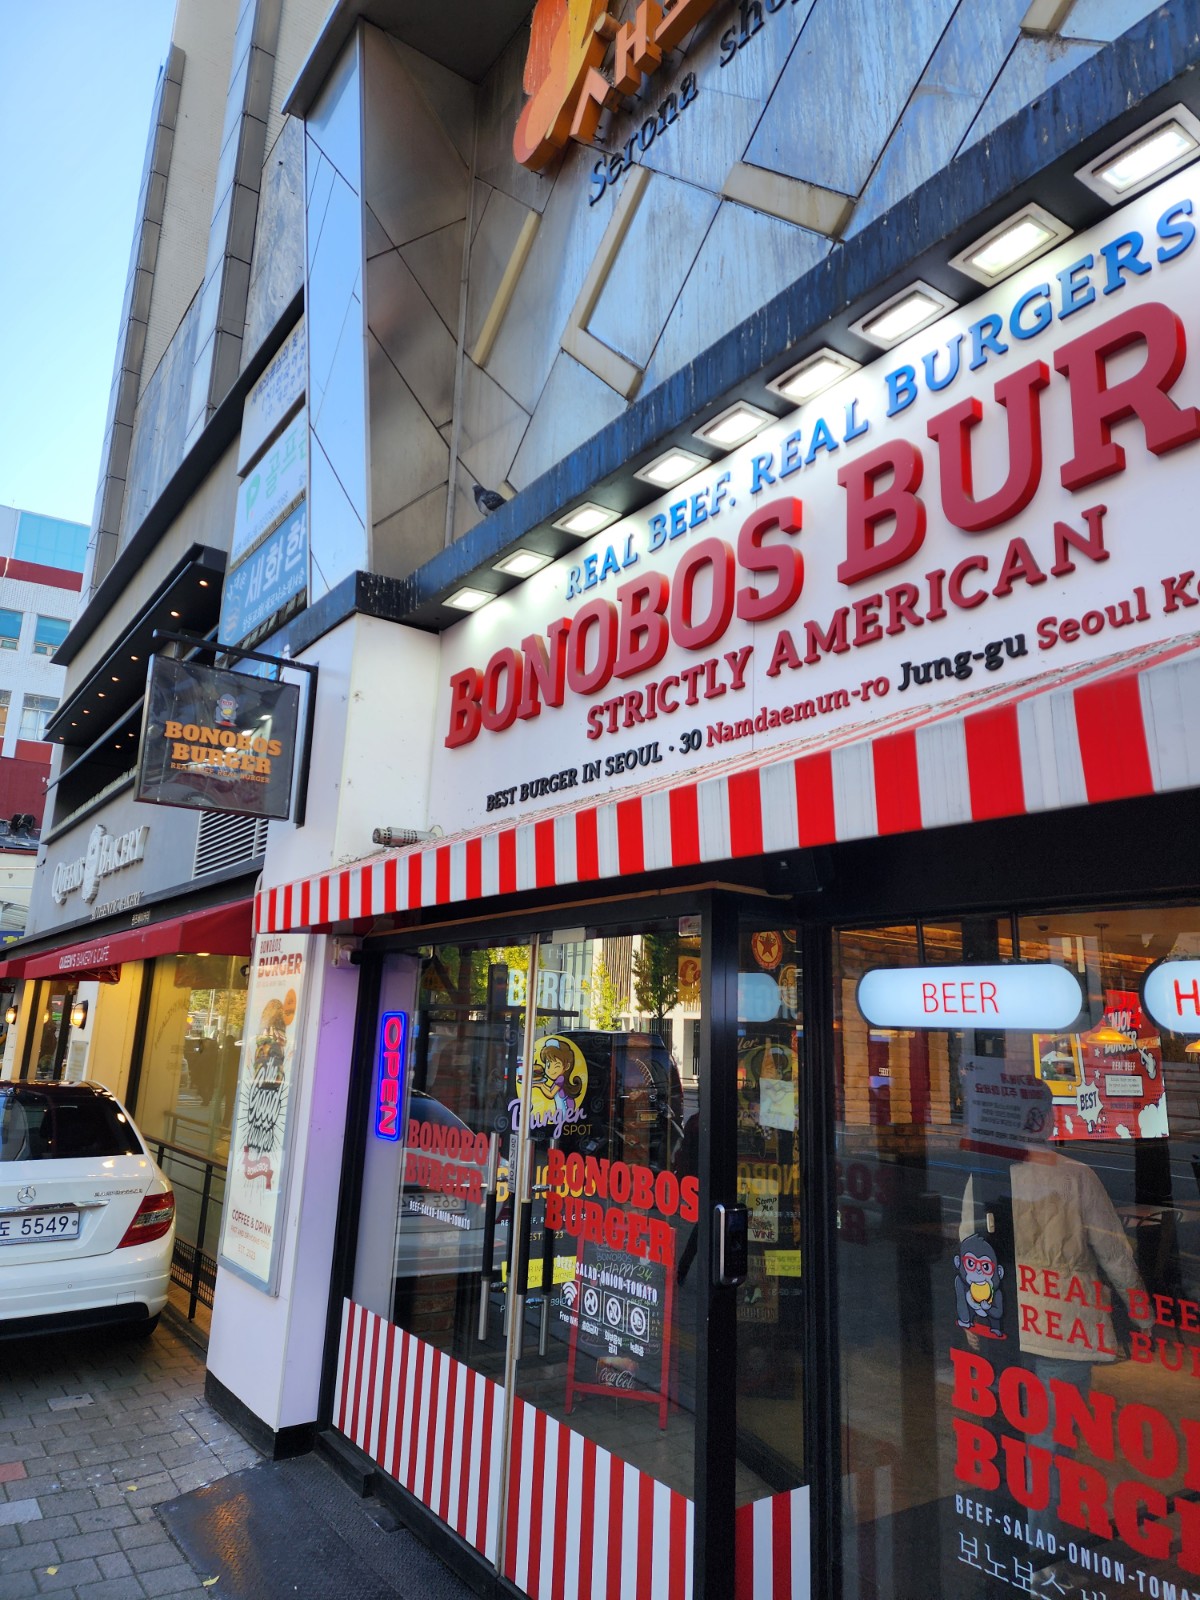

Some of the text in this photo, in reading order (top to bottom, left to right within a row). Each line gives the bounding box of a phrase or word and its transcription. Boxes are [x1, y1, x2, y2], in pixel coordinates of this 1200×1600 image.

[589, 71, 699, 207] Serona
[565, 198, 1196, 600] REAL BEEF. REAL BURGERS
[444, 302, 1200, 749] BONOBOS BUR
[587, 505, 1109, 740] STRICTLY AMERICAN
[486, 570, 1200, 812] BEST BURGER IN SEOUL 30 Namdaemun-ro Jung-gu Seoul K
[164, 720, 282, 757] BONOBOS
[171, 742, 271, 774] BURGER
[240, 772, 270, 784] BURGER
[96, 825, 150, 878] BAKERY
[59, 953, 76, 970] QUEEN'S
[76, 950, 92, 967] BAKERY
[260, 937, 282, 954] BONOBOS
[257, 952, 302, 978] BURGER
[921, 981, 999, 1014] BEER
[378, 1018, 401, 1135] OPEN
[1111, 1061, 1136, 1072] REAL BEEF
[1079, 1090, 1097, 1111] BEST
[563, 1124, 592, 1136] SPOT
[246, 1162, 269, 1176] BONOBOS
[403, 1152, 483, 1205] BURGER
[547, 1148, 699, 1223] BONOBOS
[21, 1215, 69, 1236] 5549
[231, 1208, 272, 1236] COFFEE & DRINK
[545, 1190, 673, 1269] BURGER
[603, 1262, 639, 1278] HAPPY
[1017, 1264, 1113, 1313] REAL
[559, 1311, 569, 1322] Free
[1020, 1303, 1116, 1355] REAL
